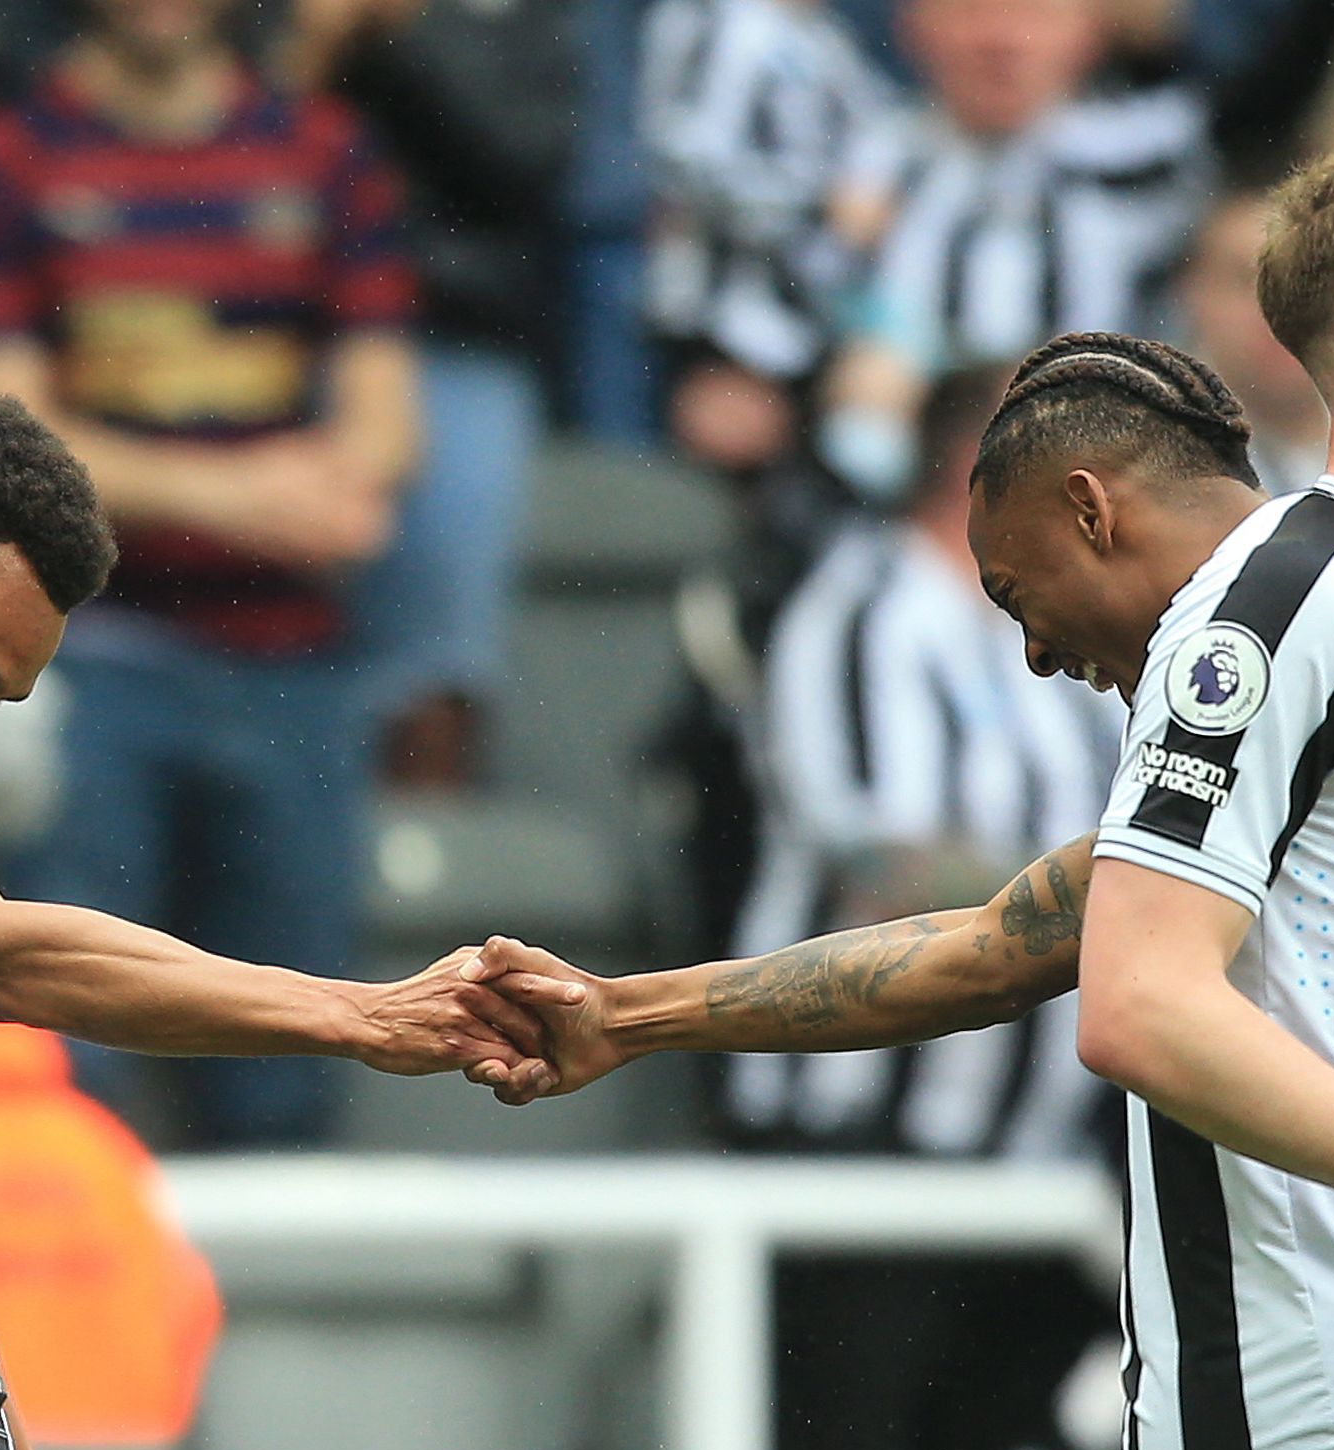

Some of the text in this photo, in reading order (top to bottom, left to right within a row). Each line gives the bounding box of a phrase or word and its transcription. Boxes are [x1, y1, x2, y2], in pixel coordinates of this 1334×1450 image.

[1138, 742, 1227, 787] No room
[1158, 771, 1230, 809] racism
